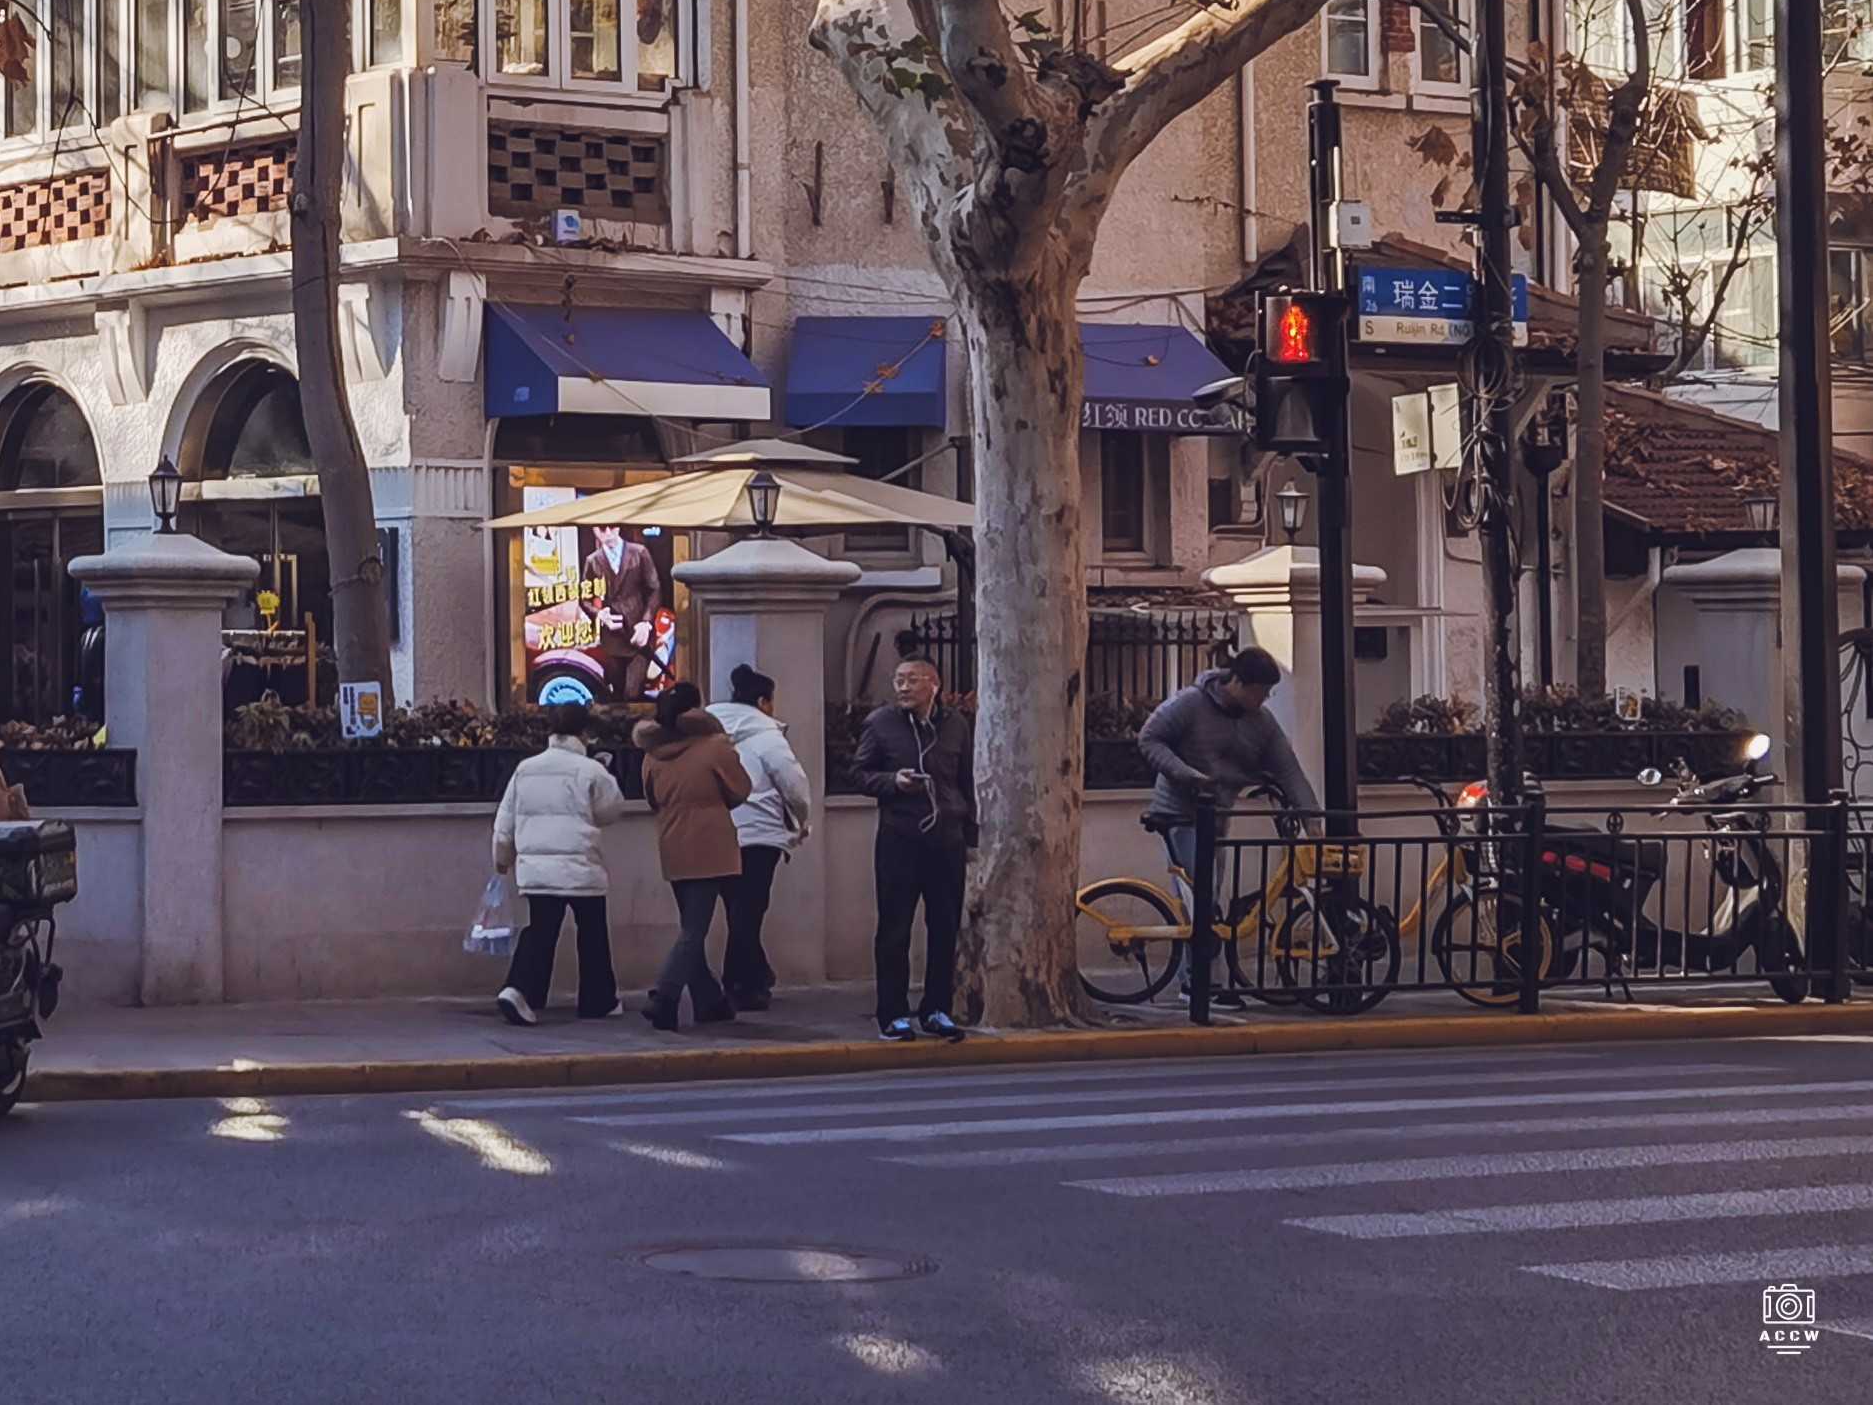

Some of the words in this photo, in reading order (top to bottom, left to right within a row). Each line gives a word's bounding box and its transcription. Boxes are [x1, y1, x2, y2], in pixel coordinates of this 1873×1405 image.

[1392, 279, 1473, 310] 瑞金二
[1365, 320, 1375, 335] S
[1135, 407, 1172, 427] RED
